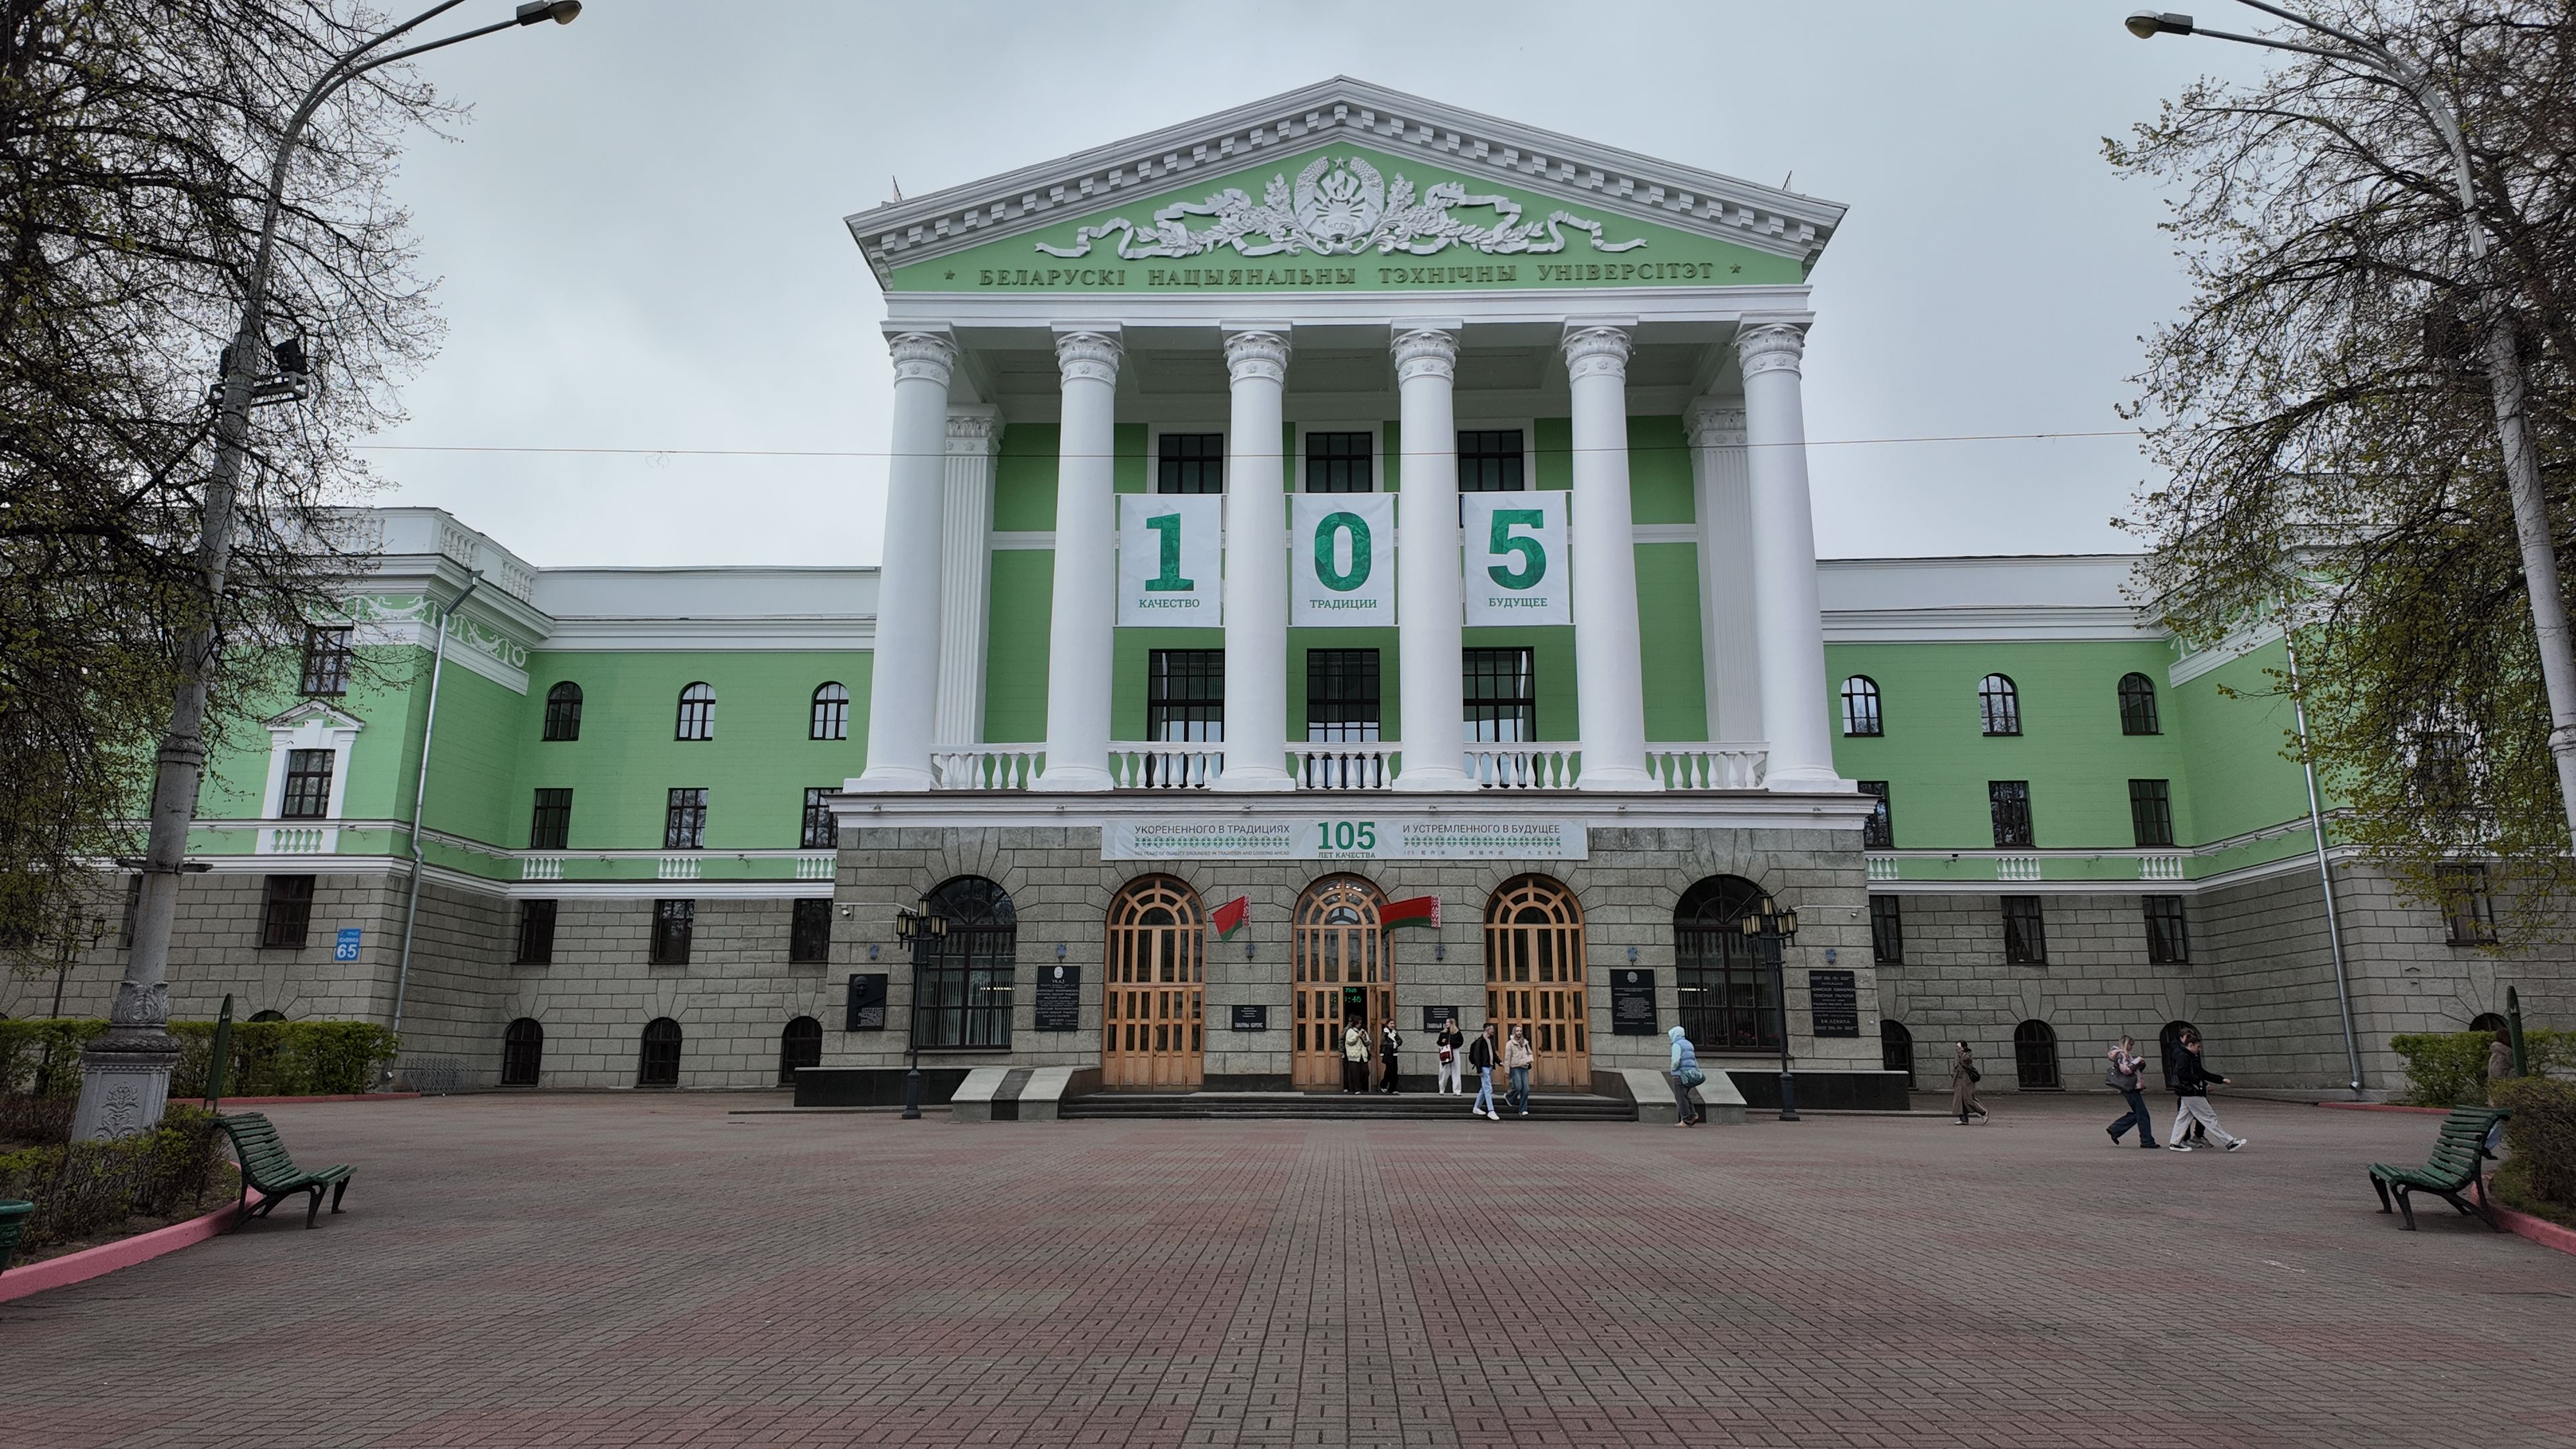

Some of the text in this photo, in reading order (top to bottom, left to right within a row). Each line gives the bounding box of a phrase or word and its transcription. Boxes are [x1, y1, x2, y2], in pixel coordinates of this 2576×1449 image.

[979, 262, 1713, 287] БЕЛАРУСКІ НАЦЫЯНАЛЬНЫ ТЭХНІЧНЫ УНІВЕРСІТЭТ
[1145, 513, 1194, 592] 1
[1314, 511, 1372, 592] 0
[1487, 509, 1547, 590] 5
[1139, 598, 1200, 608] КАЧЕСТВО
[1309, 599, 1377, 610] ТРАДИЦИИ
[1489, 598, 1548, 608] БУДУЩЕЕ
[1135, 825, 1290, 835] УКОРЕНЕННОГО В ТРАДИЦИЯХ
[1318, 821, 1376, 850] 105
[1403, 824, 1560, 835] И УСТРЕМЛЕННОГО В БУДУЩЕЕ
[337, 943, 357, 959] 65
